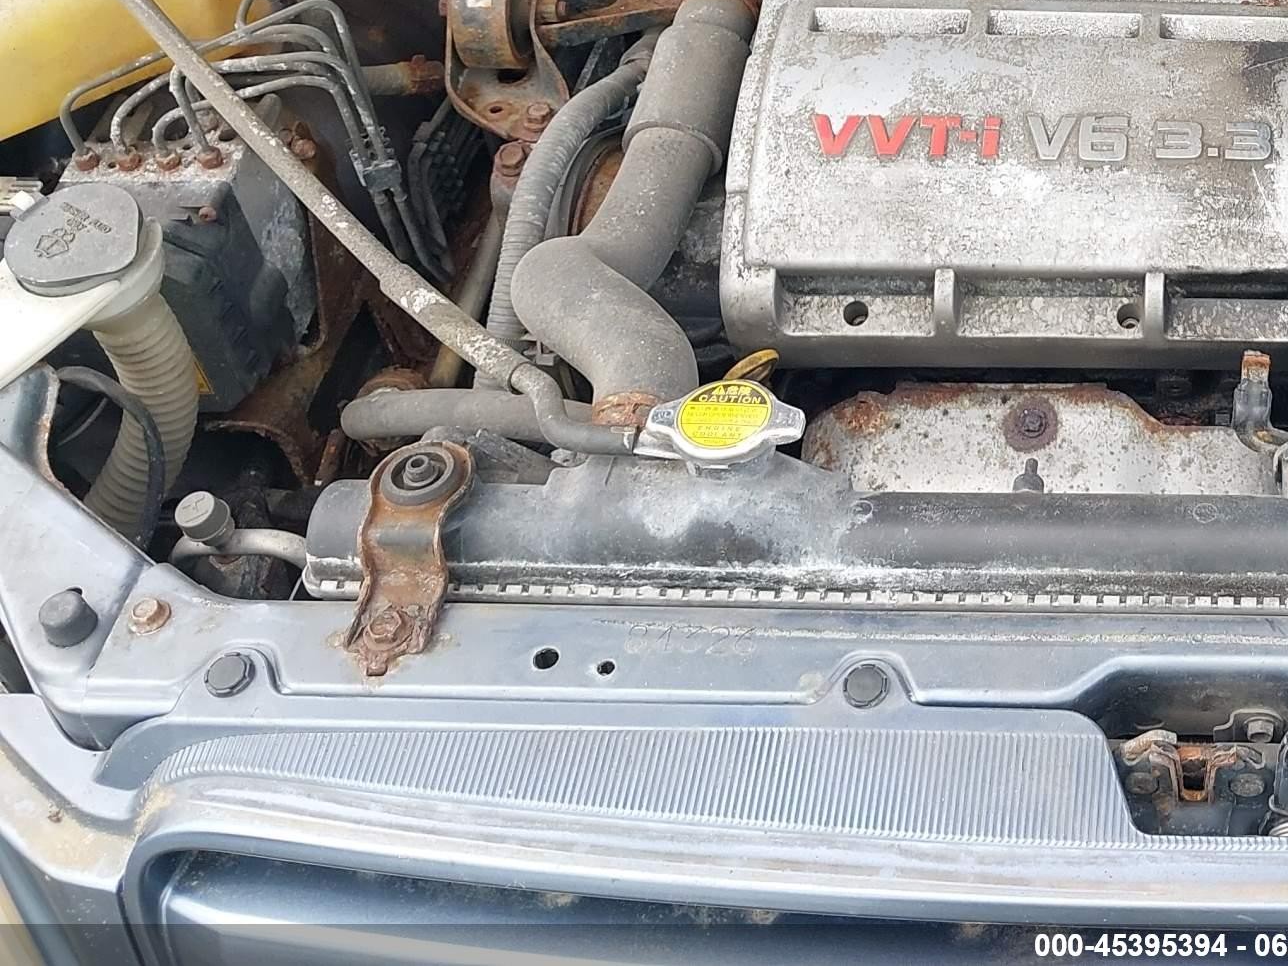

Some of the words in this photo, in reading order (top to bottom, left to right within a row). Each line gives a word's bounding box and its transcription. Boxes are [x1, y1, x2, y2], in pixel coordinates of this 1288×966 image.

[812, 113, 1003, 160] VVT-i
[1026, 111, 1131, 162] V6
[1153, 119, 1273, 163] 3.3
[698, 394, 762, 404] CAUTION
